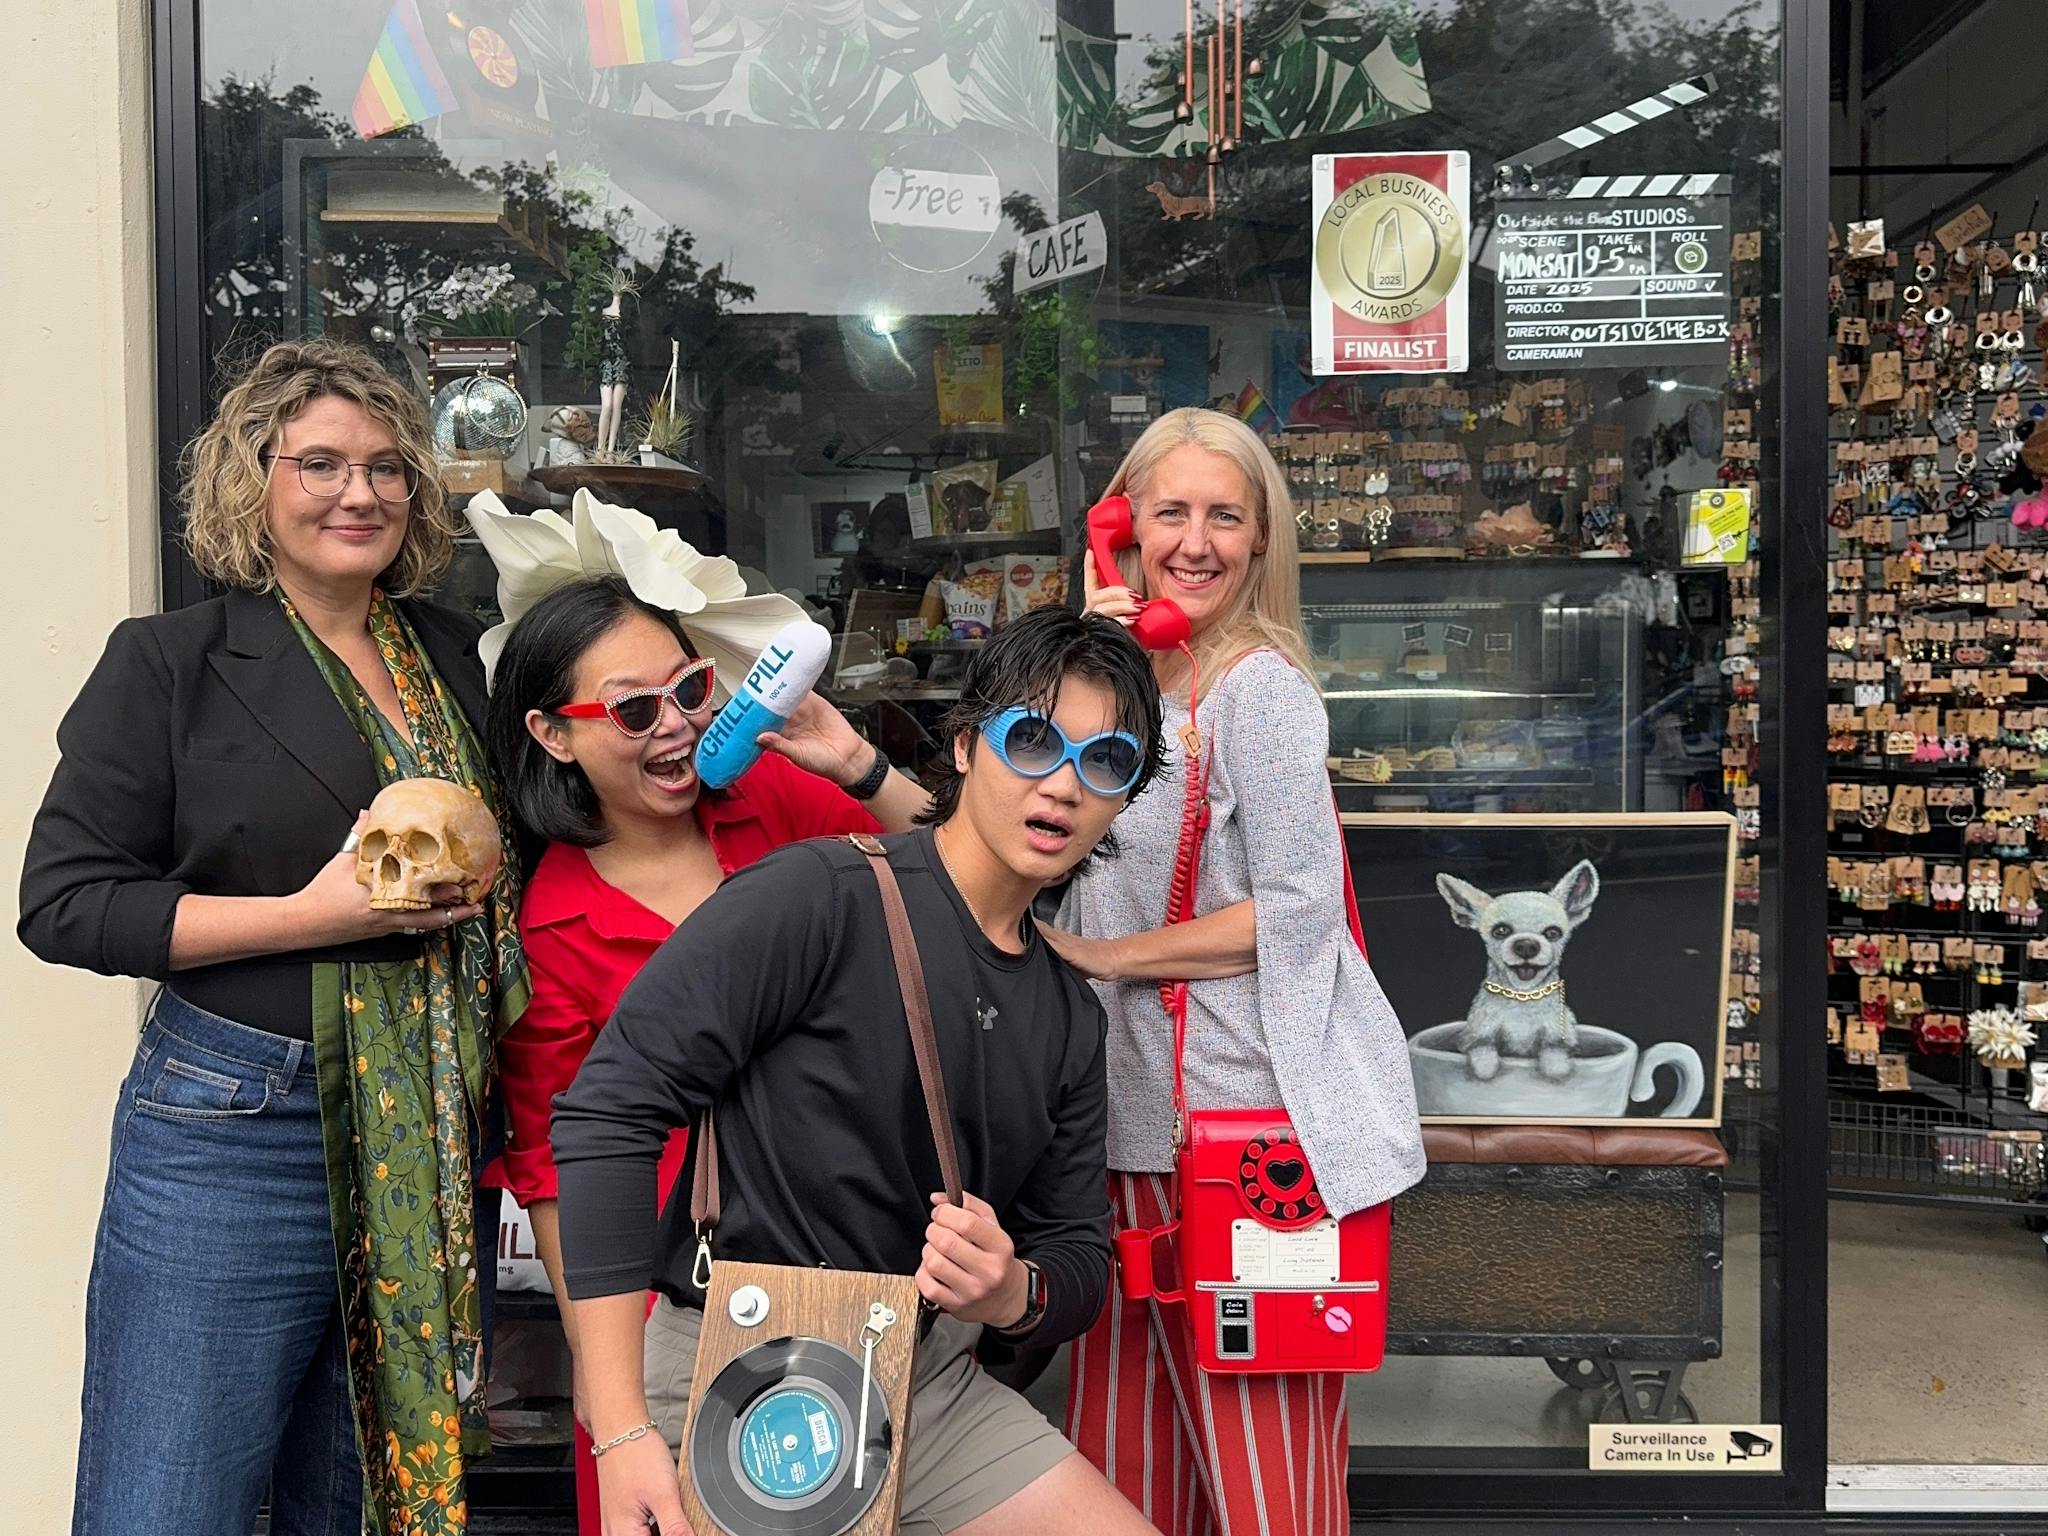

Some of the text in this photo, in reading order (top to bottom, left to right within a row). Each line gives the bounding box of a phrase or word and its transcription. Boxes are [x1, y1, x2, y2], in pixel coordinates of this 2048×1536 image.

[1328, 179, 1454, 227] LOCAL BUSINESS
[1497, 213, 1558, 228] Outside
[1518, 236, 1567, 247] SCENE
[1597, 233, 1634, 245] TAKE
[1671, 232, 1708, 242] ROLL
[1028, 221, 1088, 279] CAFE
[1379, 276, 1400, 285] 2025
[1646, 280, 1697, 293] SOUND
[1507, 282, 1593, 296] DATE 2025
[1351, 298, 1424, 321] AWARDS
[1507, 325, 1569, 338] DIRECTOR
[1344, 340, 1437, 359] FINALIST
[1507, 348, 1583, 361] CAMERAMAN
[747, 645, 794, 694] PILL
[701, 697, 755, 758] CHILL
[498, 1265, 514, 1275] mg
[814, 1419, 827, 1446] DECCA
[1612, 1432, 1707, 1445] Surveillance
[1604, 1449, 1715, 1461] Camera In Use
